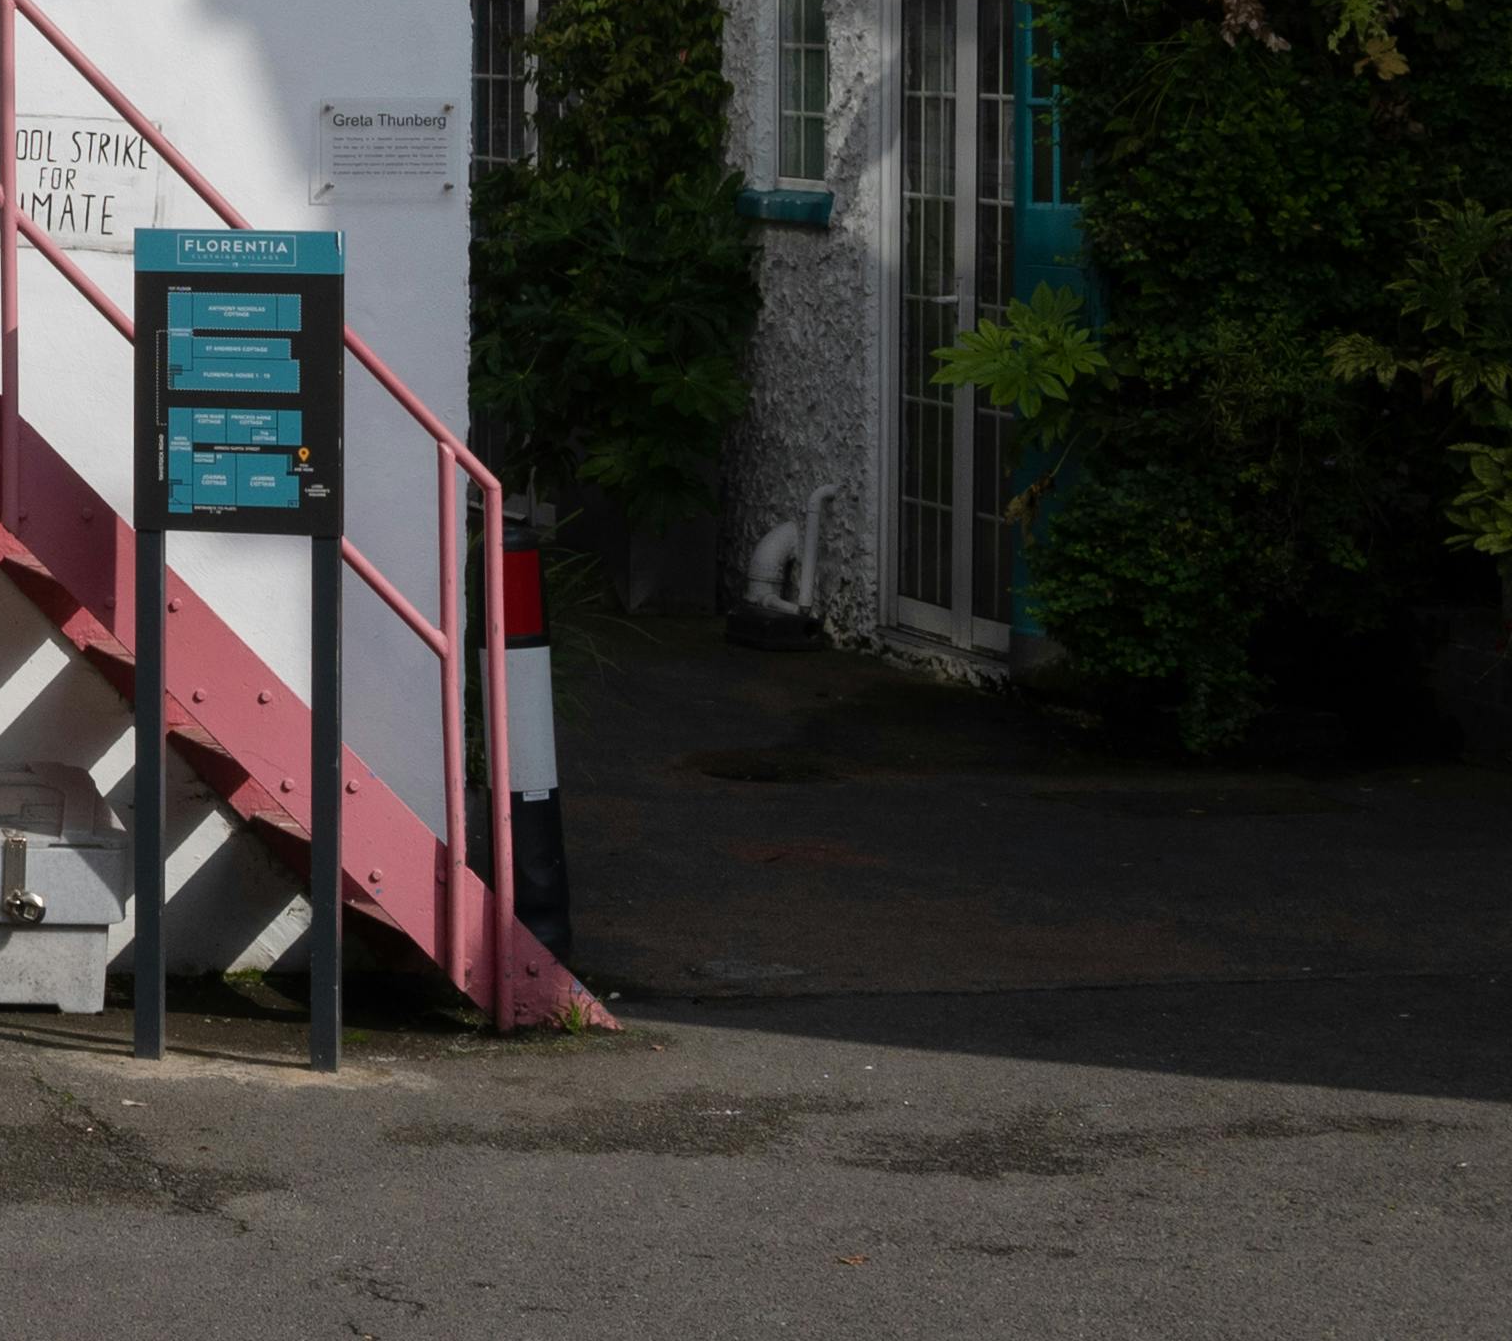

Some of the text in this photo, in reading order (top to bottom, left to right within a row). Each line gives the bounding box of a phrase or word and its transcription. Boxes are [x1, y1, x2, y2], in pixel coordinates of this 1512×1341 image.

[332, 113, 447, 130] Greta Thunberg
[71, 131, 148, 170] STRIKE
[39, 167, 77, 190] FOR
[184, 239, 289, 254] FLORENTIA
